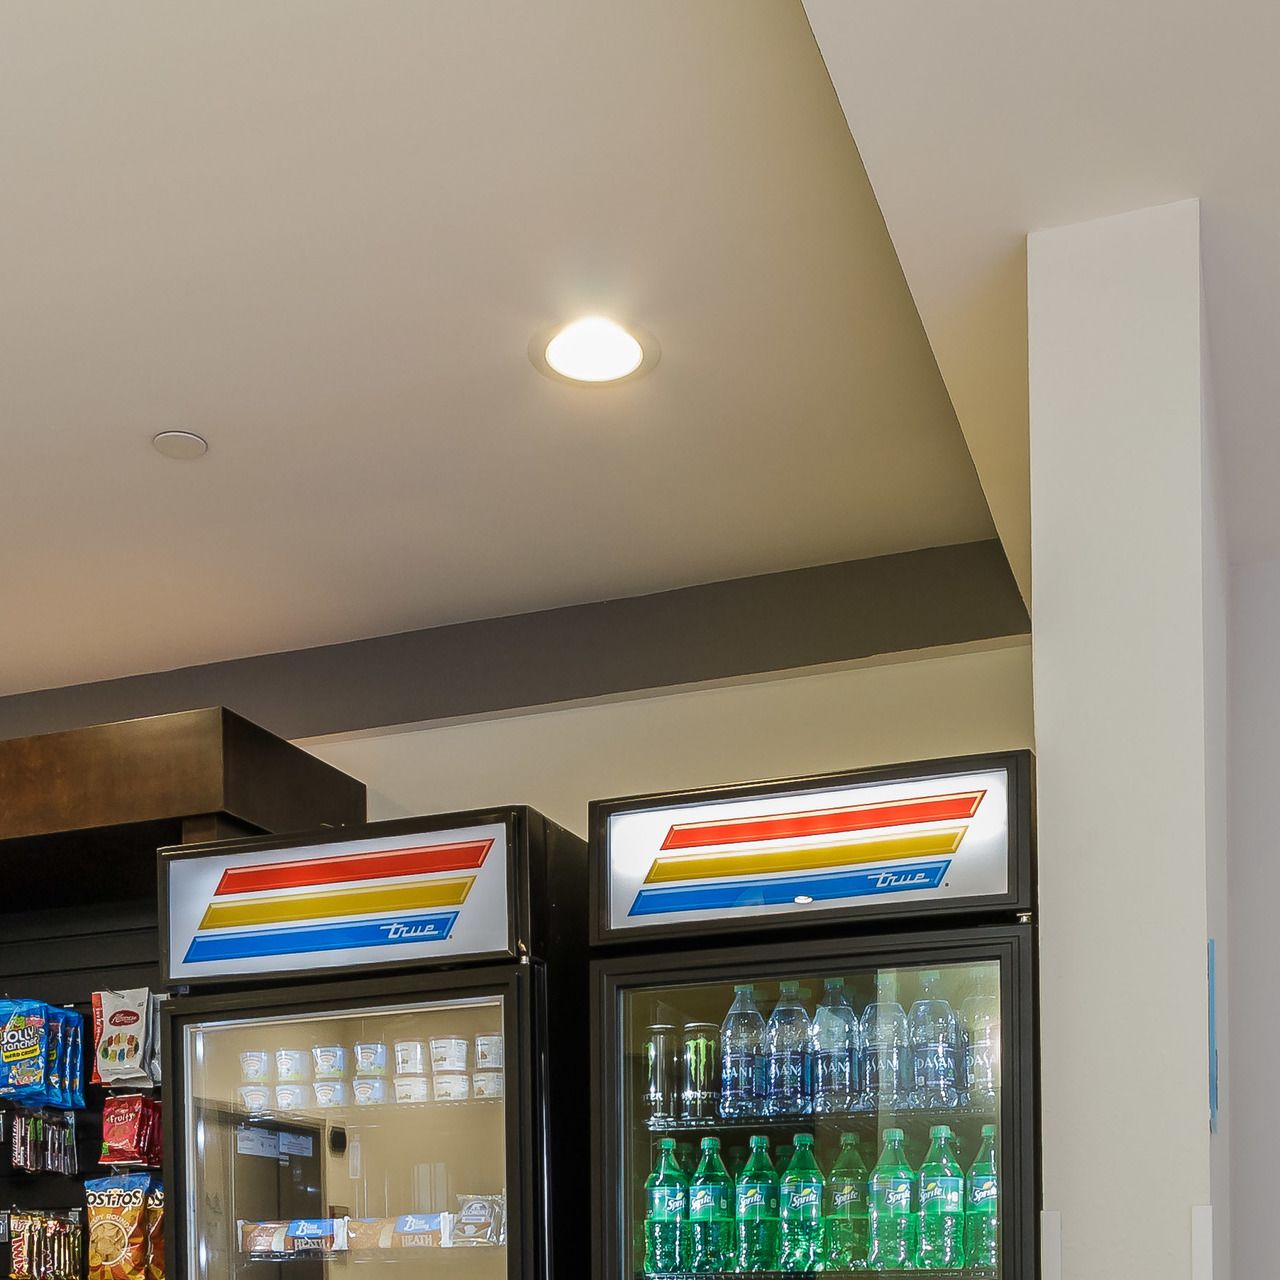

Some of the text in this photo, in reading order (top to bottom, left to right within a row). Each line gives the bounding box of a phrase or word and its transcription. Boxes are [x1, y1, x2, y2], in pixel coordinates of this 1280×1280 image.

[1, 1025, 34, 1045] JOLLY
[4, 1037, 39, 1052] rancher
[793, 1193, 818, 1208] Sprite
[834, 1191, 858, 1206] Sprite
